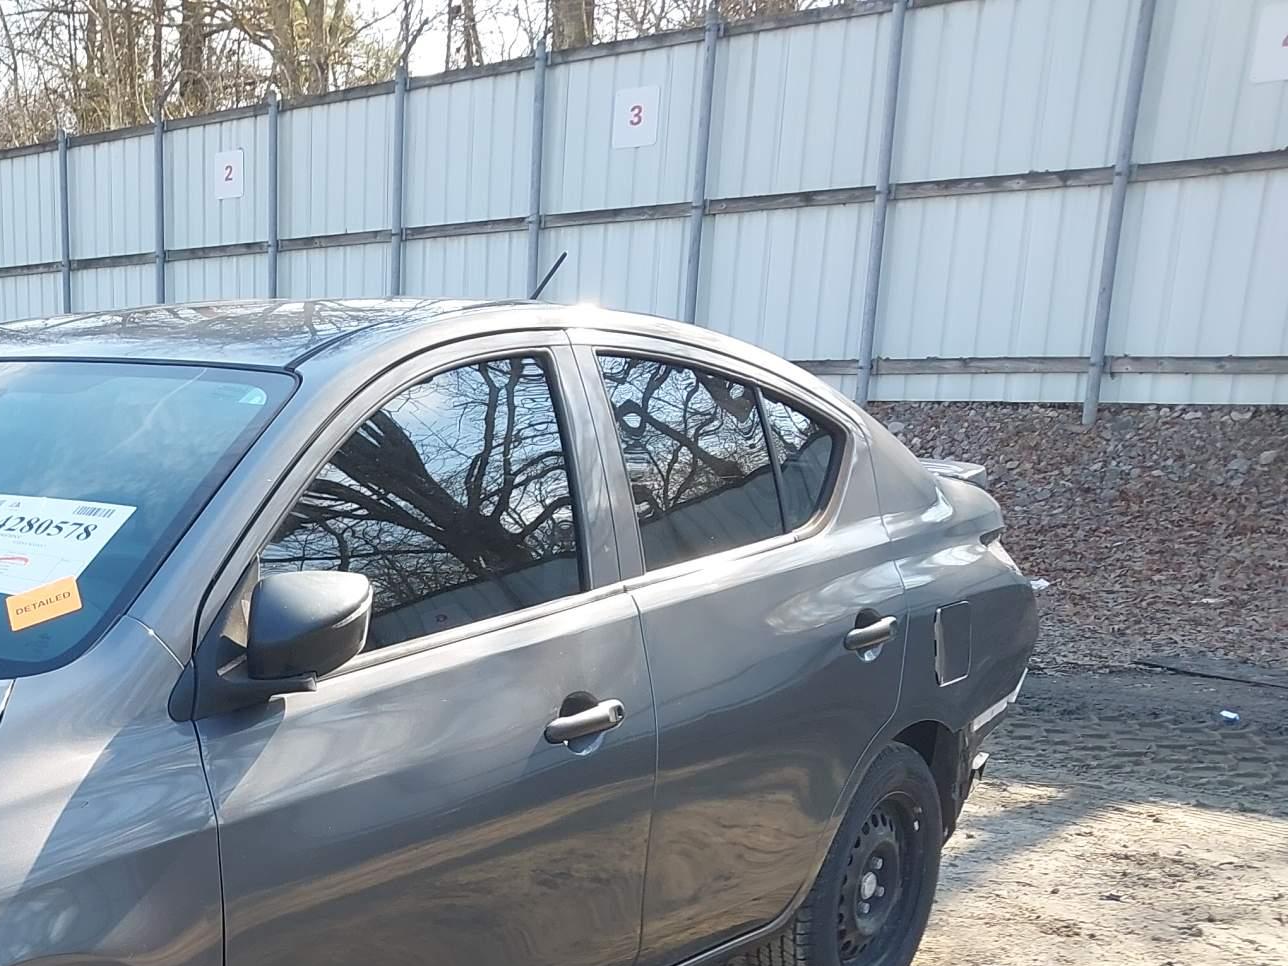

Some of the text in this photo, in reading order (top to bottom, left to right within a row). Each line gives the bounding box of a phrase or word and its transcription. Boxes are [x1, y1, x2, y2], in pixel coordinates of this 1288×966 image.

[630, 105, 642, 126] 3
[224, 165, 233, 182] 2
[15, 590, 72, 616] DETAILED
